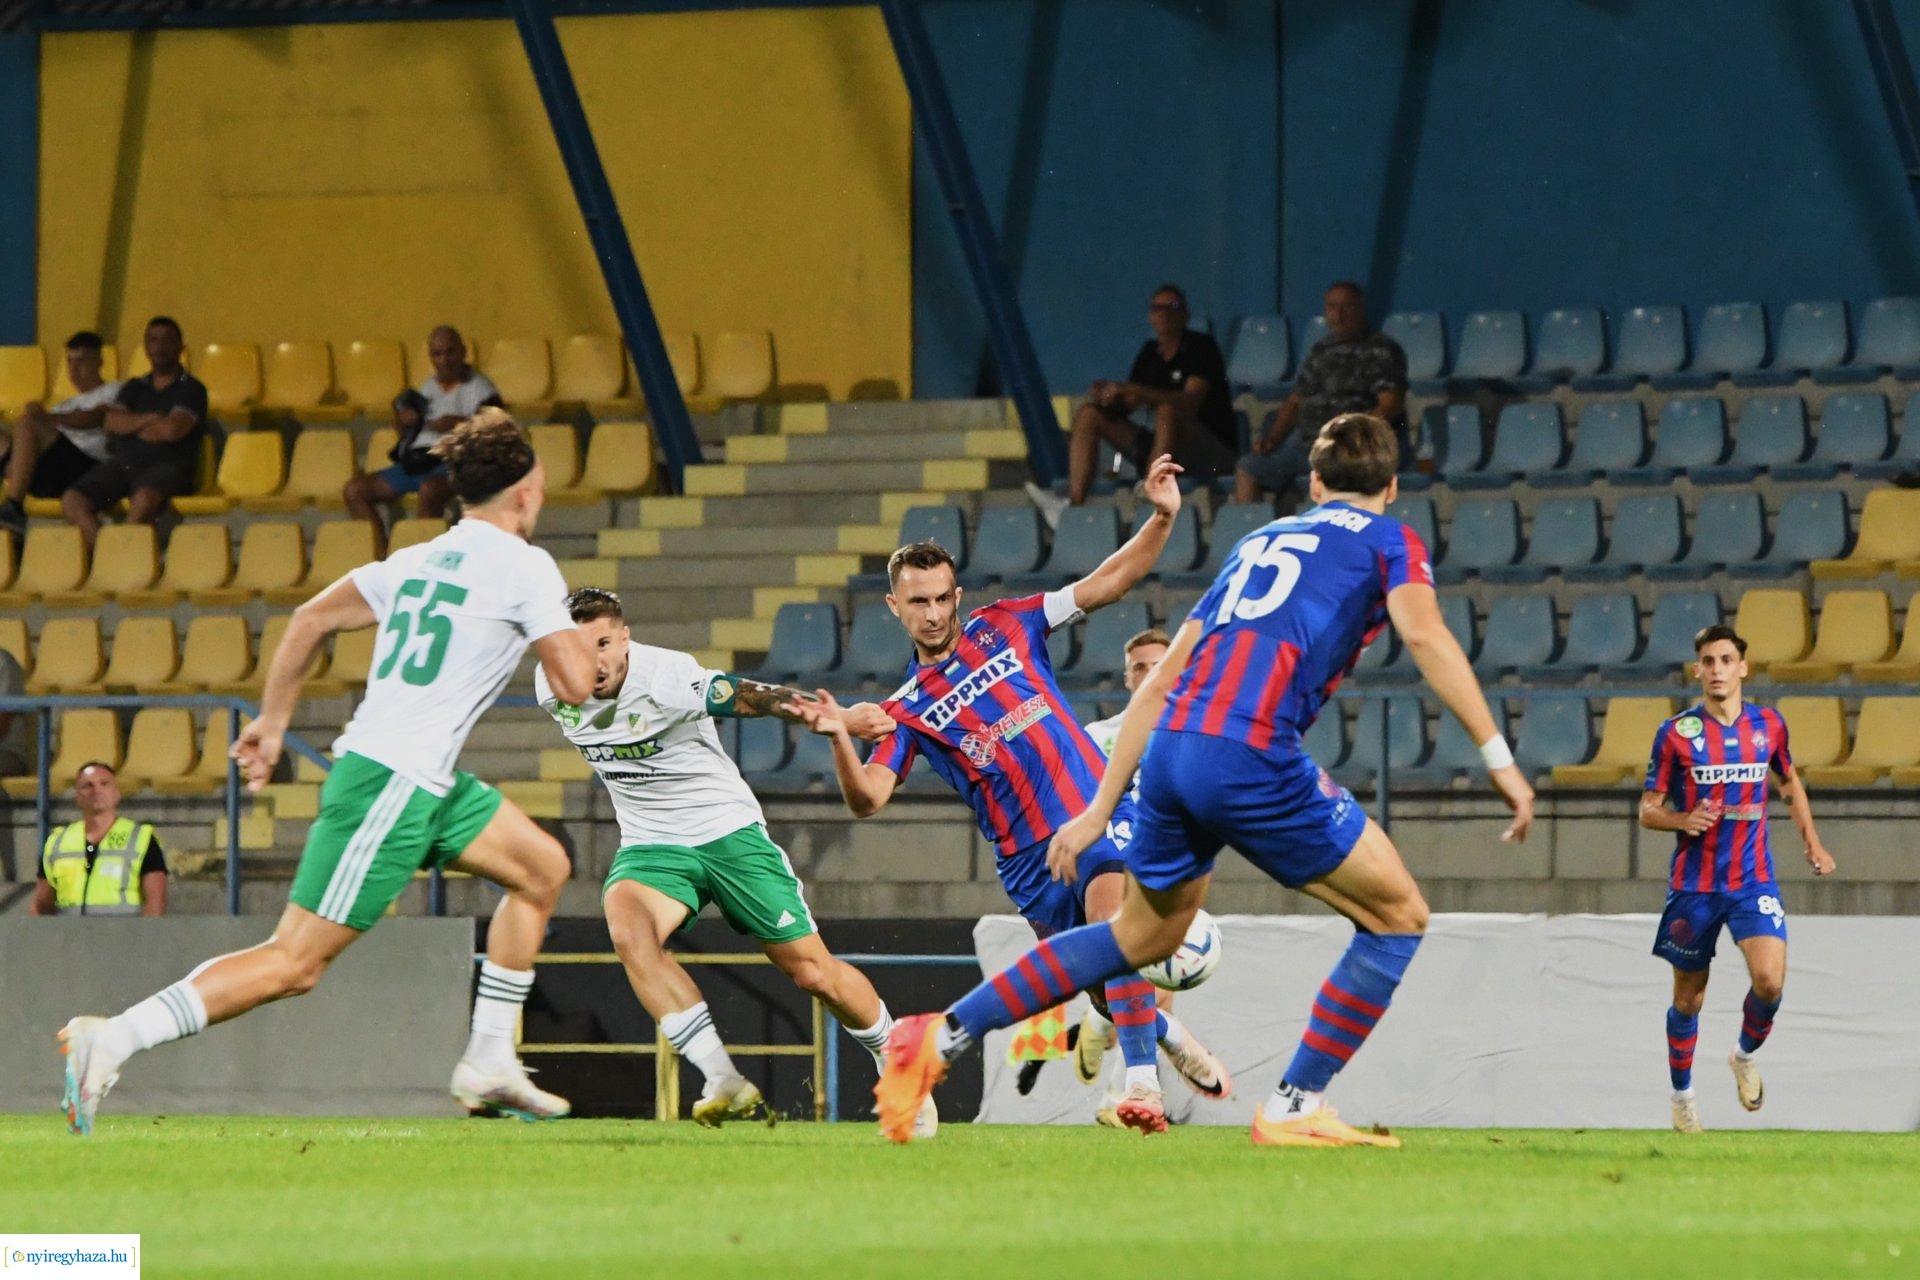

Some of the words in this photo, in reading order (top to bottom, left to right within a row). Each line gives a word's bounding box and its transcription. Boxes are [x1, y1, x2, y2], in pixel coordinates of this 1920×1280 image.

[1216, 534, 1320, 625] 15
[377, 579, 469, 686] 55
[579, 740, 664, 761] iPPMIX
